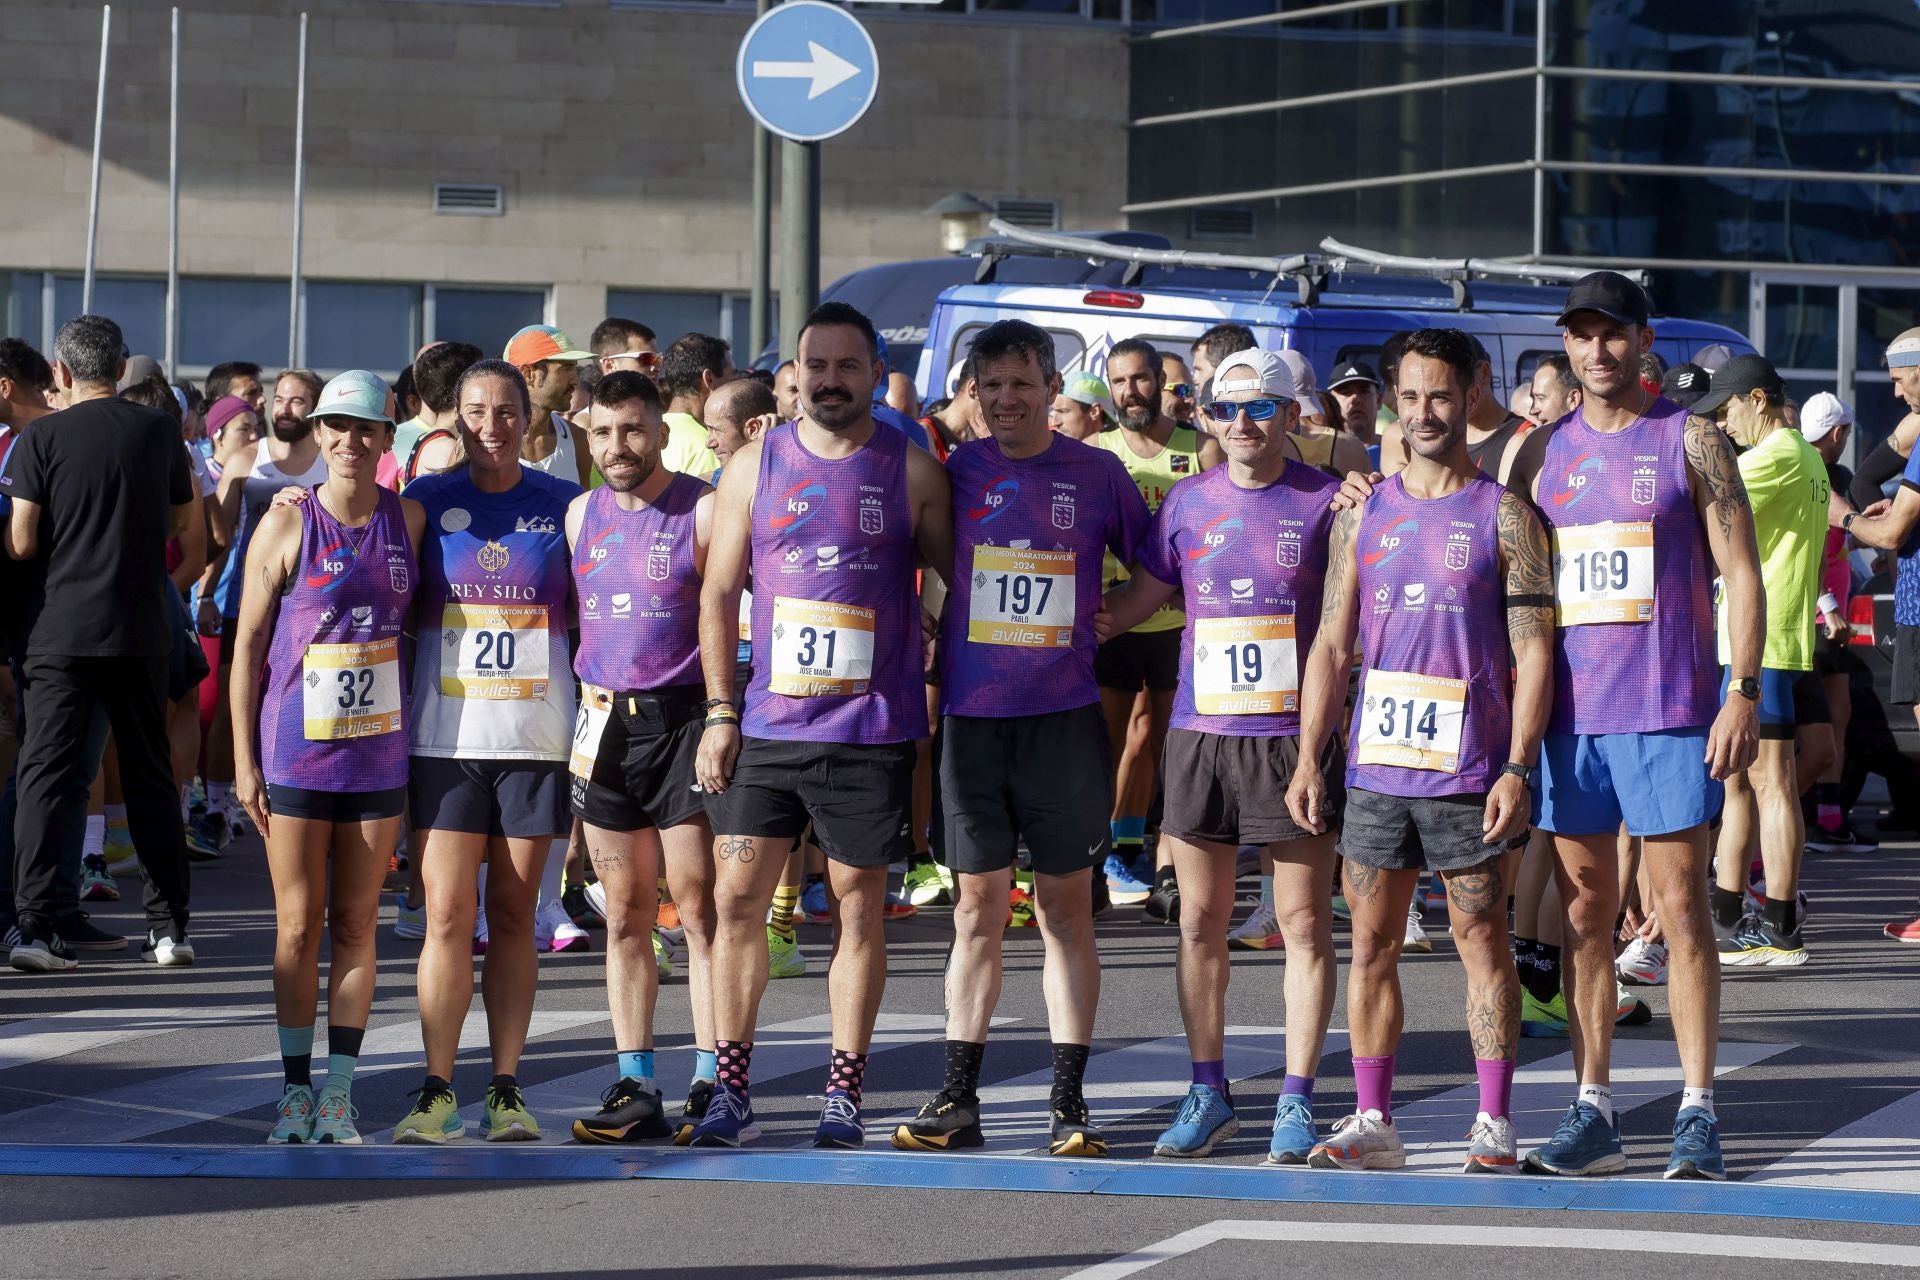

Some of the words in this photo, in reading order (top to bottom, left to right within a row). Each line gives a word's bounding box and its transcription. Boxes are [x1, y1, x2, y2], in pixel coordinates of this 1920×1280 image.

[1052, 482, 1076, 491] VESKIN
[1568, 474, 1586, 489] kp
[860, 485, 884, 493] VESKIN
[787, 498, 808, 515] kp
[985, 492, 1003, 508] kp
[1279, 519, 1304, 527] VESKIN
[1451, 520, 1475, 529] VESKIN
[1204, 531, 1225, 547] kp
[1380, 534, 1400, 550] kp
[590, 545, 607, 562] kp
[1017, 551, 1051, 560] MARATÓN
[323, 558, 344, 575] kp
[1013, 561, 1035, 570] 2024
[1574, 550, 1628, 592] 169
[451, 583, 487, 598] REY
[493, 585, 536, 600] SILO
[996, 574, 1054, 615] 197
[490, 607, 522, 615] MARATÓN
[523, 607, 546, 615] AVILÉS
[815, 605, 850, 615] MARATÓN
[1449, 605, 1464, 613] SILO
[1011, 614, 1029, 623] PABLO
[1268, 617, 1292, 625] AVILÉS
[992, 628, 1046, 644] avilés
[475, 630, 515, 670] 20
[797, 626, 836, 668] 31
[345, 656, 367, 665] 2024
[1224, 643, 1262, 683] 19
[799, 667, 813, 676] JOSE
[338, 668, 375, 708] 32
[467, 683, 522, 697] avilés
[1231, 683, 1256, 692] RODRIGO
[344, 708, 369, 717] JENNIFER
[1379, 697, 1437, 740] 314
